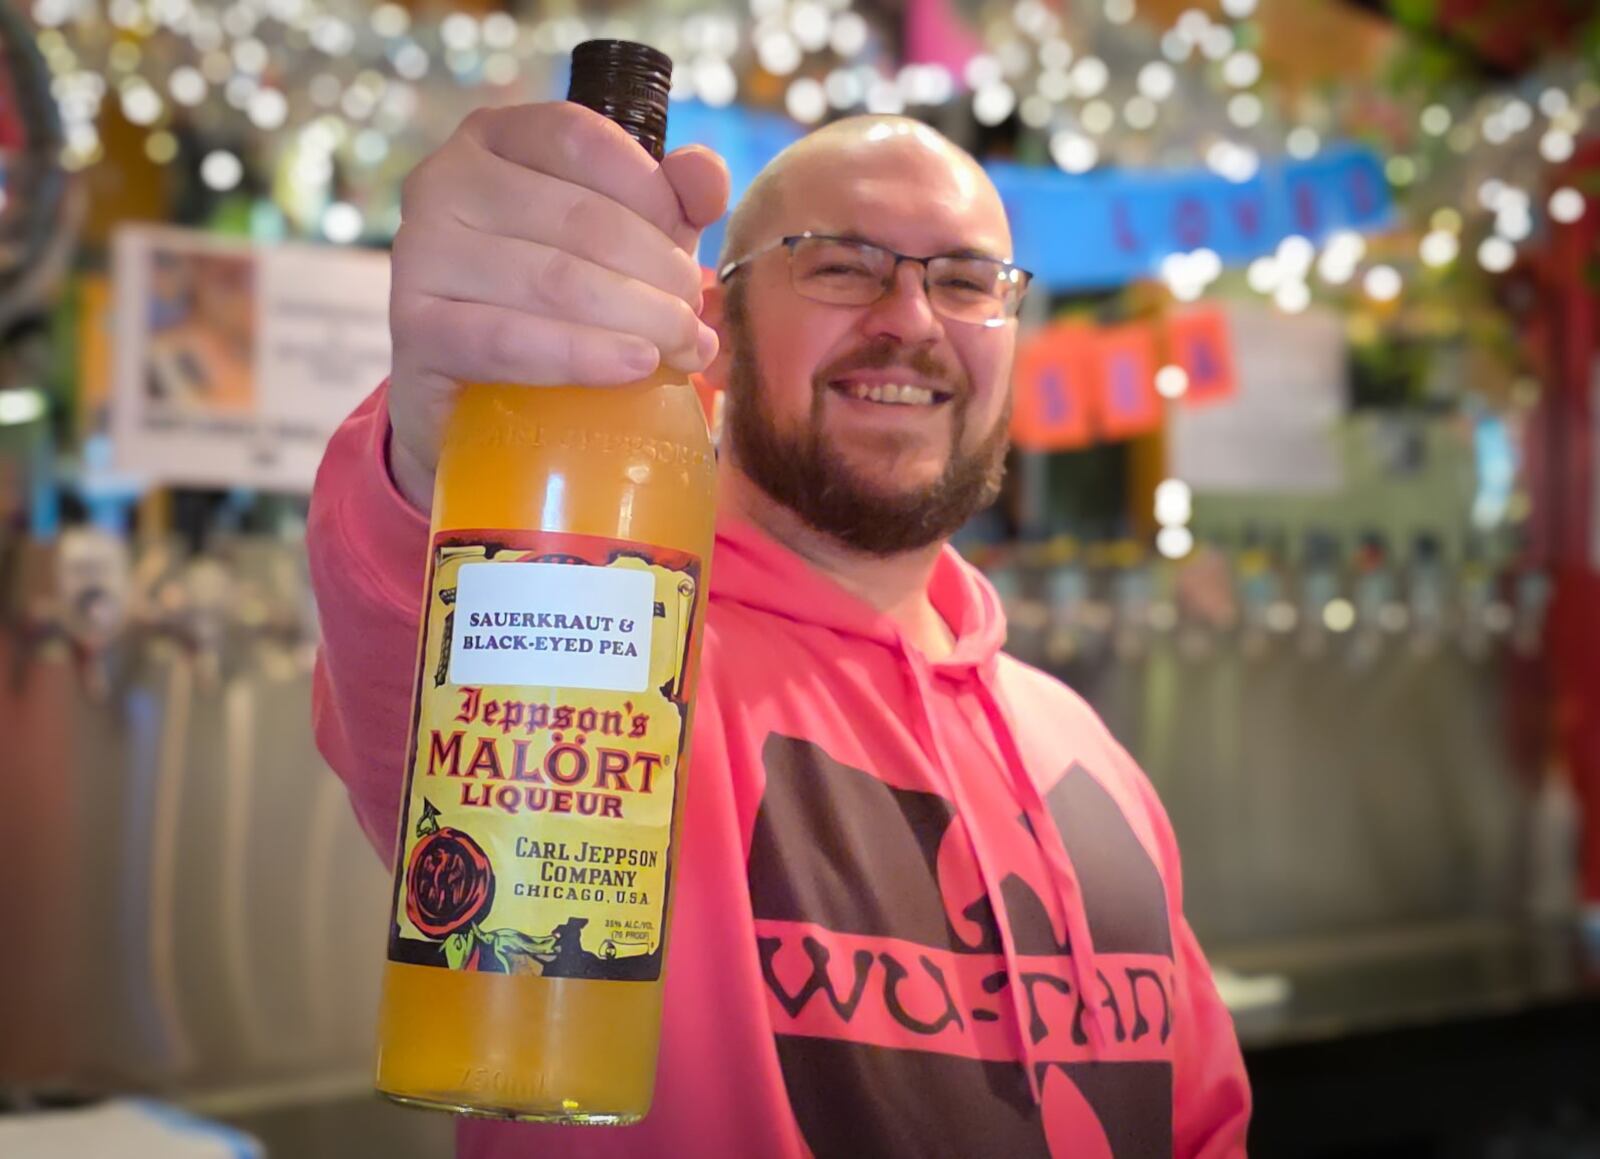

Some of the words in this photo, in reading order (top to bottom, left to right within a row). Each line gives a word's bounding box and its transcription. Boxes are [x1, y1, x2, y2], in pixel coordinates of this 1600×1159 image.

[469, 612, 614, 632] SAUERKRAUT
[618, 618, 635, 633] &
[462, 635, 594, 653] BLACK-EYED
[599, 640, 638, 657] PEA
[454, 686, 650, 738] Jeppson's
[426, 729, 663, 794] MALÖRT
[459, 782, 624, 819] LIQUEUR
[515, 836, 570, 861] CARL
[574, 841, 658, 868] JEPPSON
[541, 861, 638, 888] COMPANY
[514, 883, 610, 904] CHICAGO,
